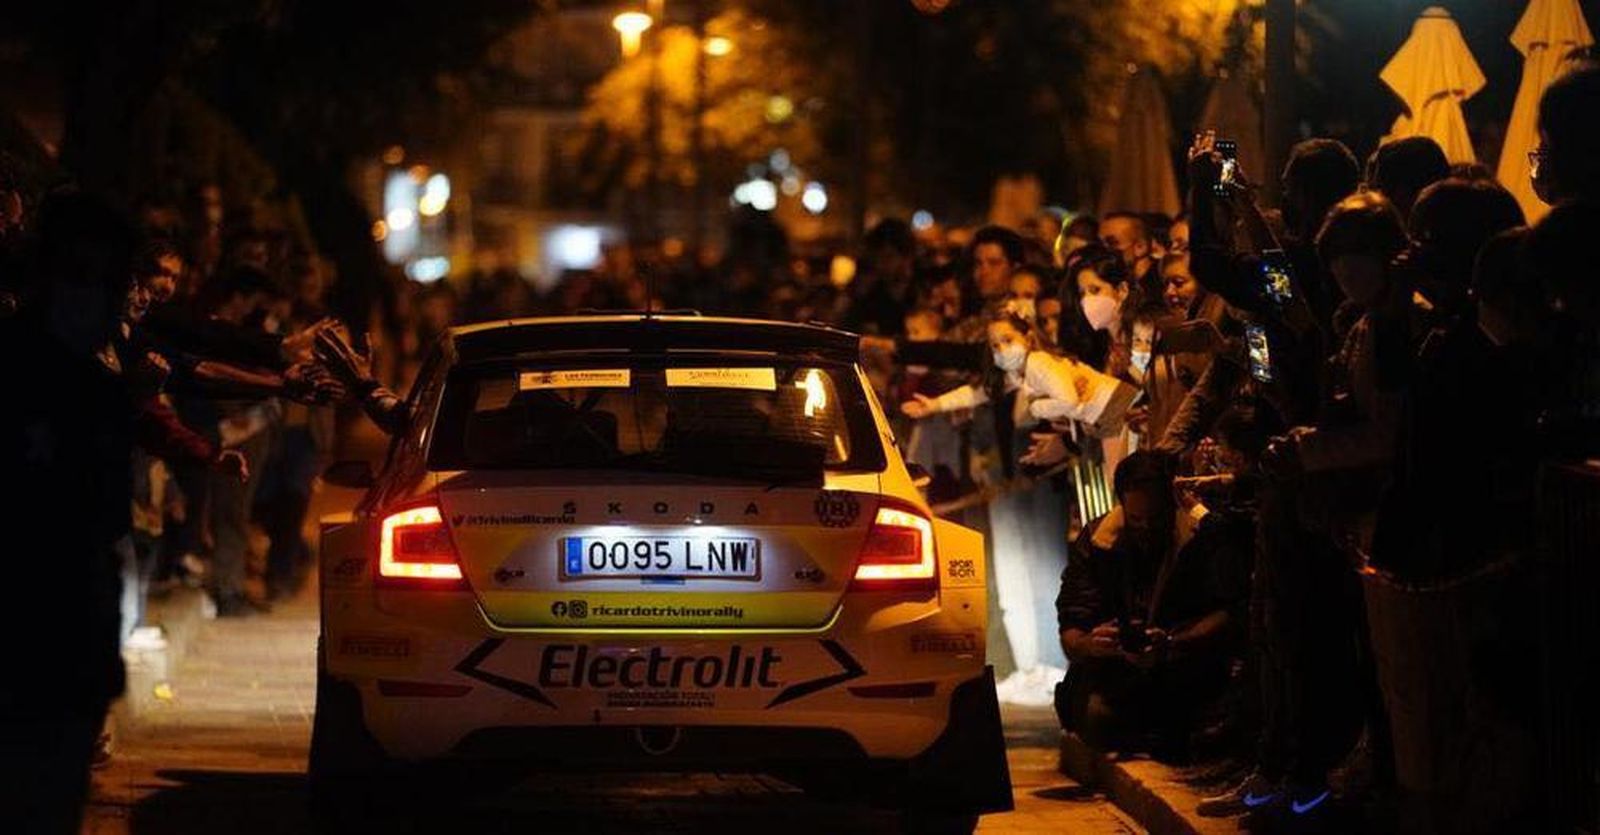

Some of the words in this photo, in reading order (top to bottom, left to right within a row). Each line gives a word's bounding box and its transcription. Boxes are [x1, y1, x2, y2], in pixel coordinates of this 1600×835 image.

[589, 541, 671, 569] 0095
[686, 541, 747, 570] LNW
[592, 605, 743, 618] ricardotrivinorally
[539, 645, 781, 687] Electrolit
